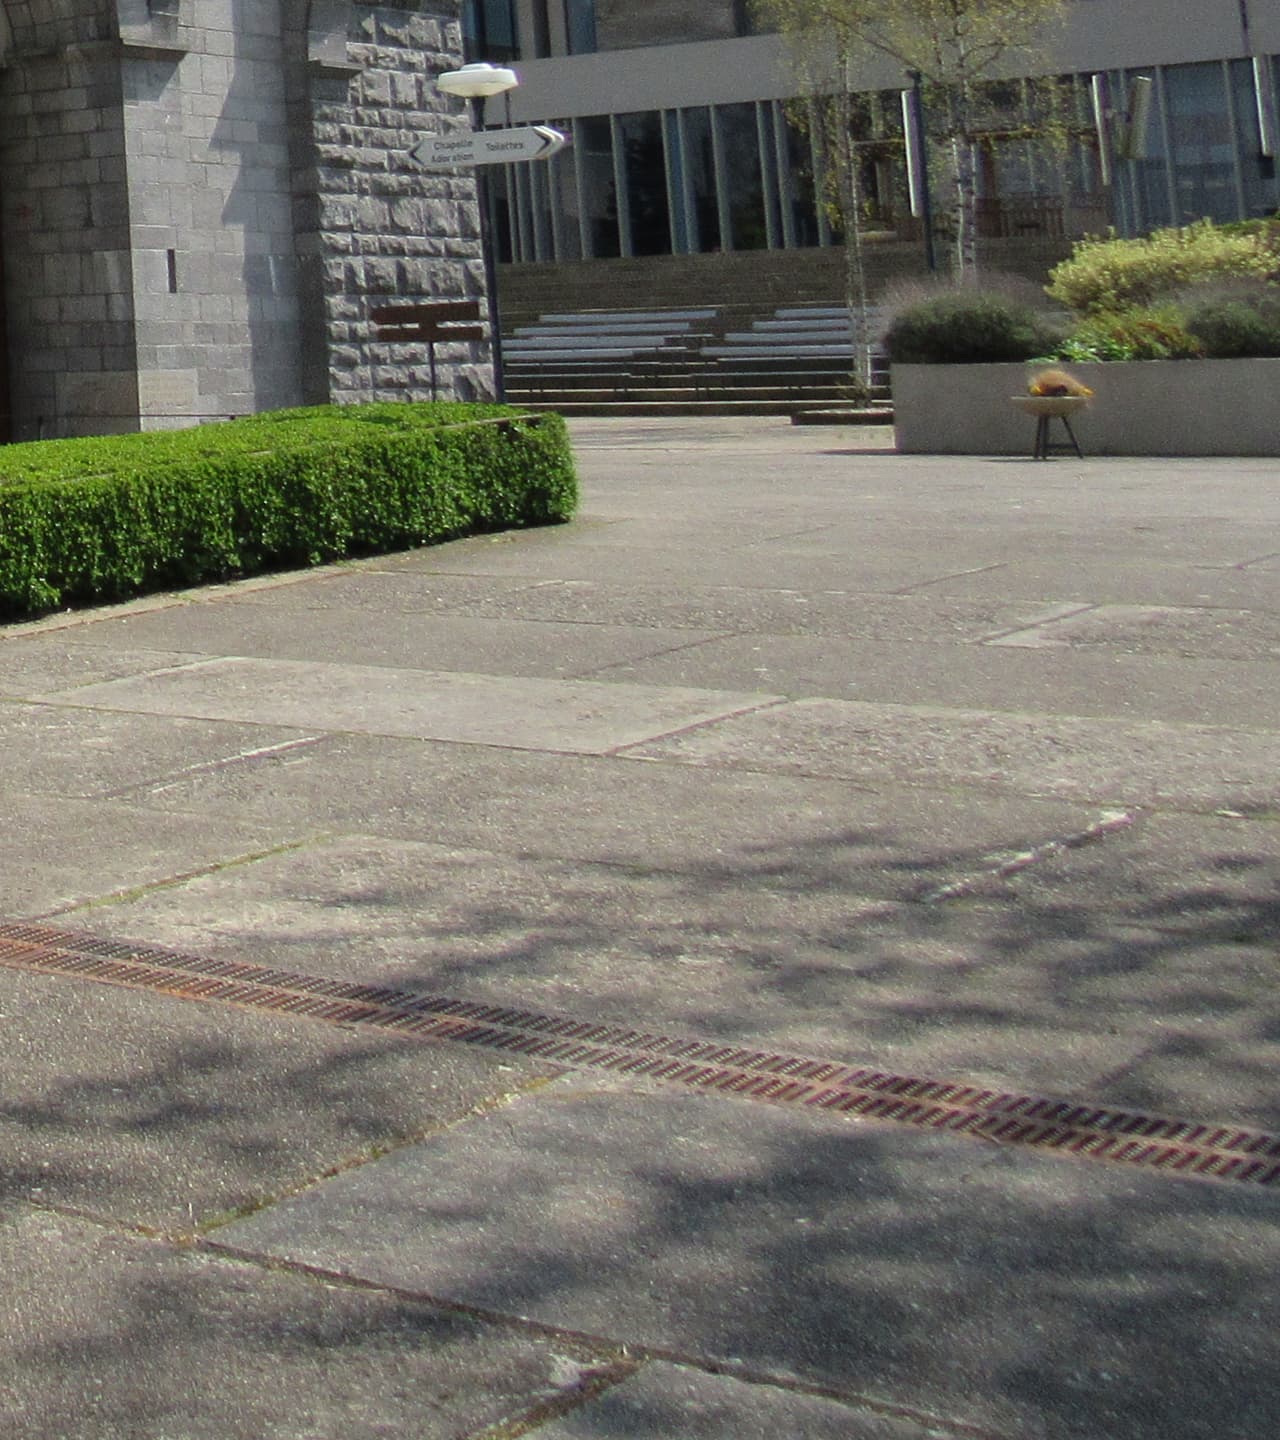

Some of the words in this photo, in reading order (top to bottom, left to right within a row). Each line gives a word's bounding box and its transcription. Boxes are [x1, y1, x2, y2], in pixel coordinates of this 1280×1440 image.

[433, 140, 473, 152] Chapelle
[486, 142, 524, 152] Toilettes
[431, 153, 473, 163] Adoration
